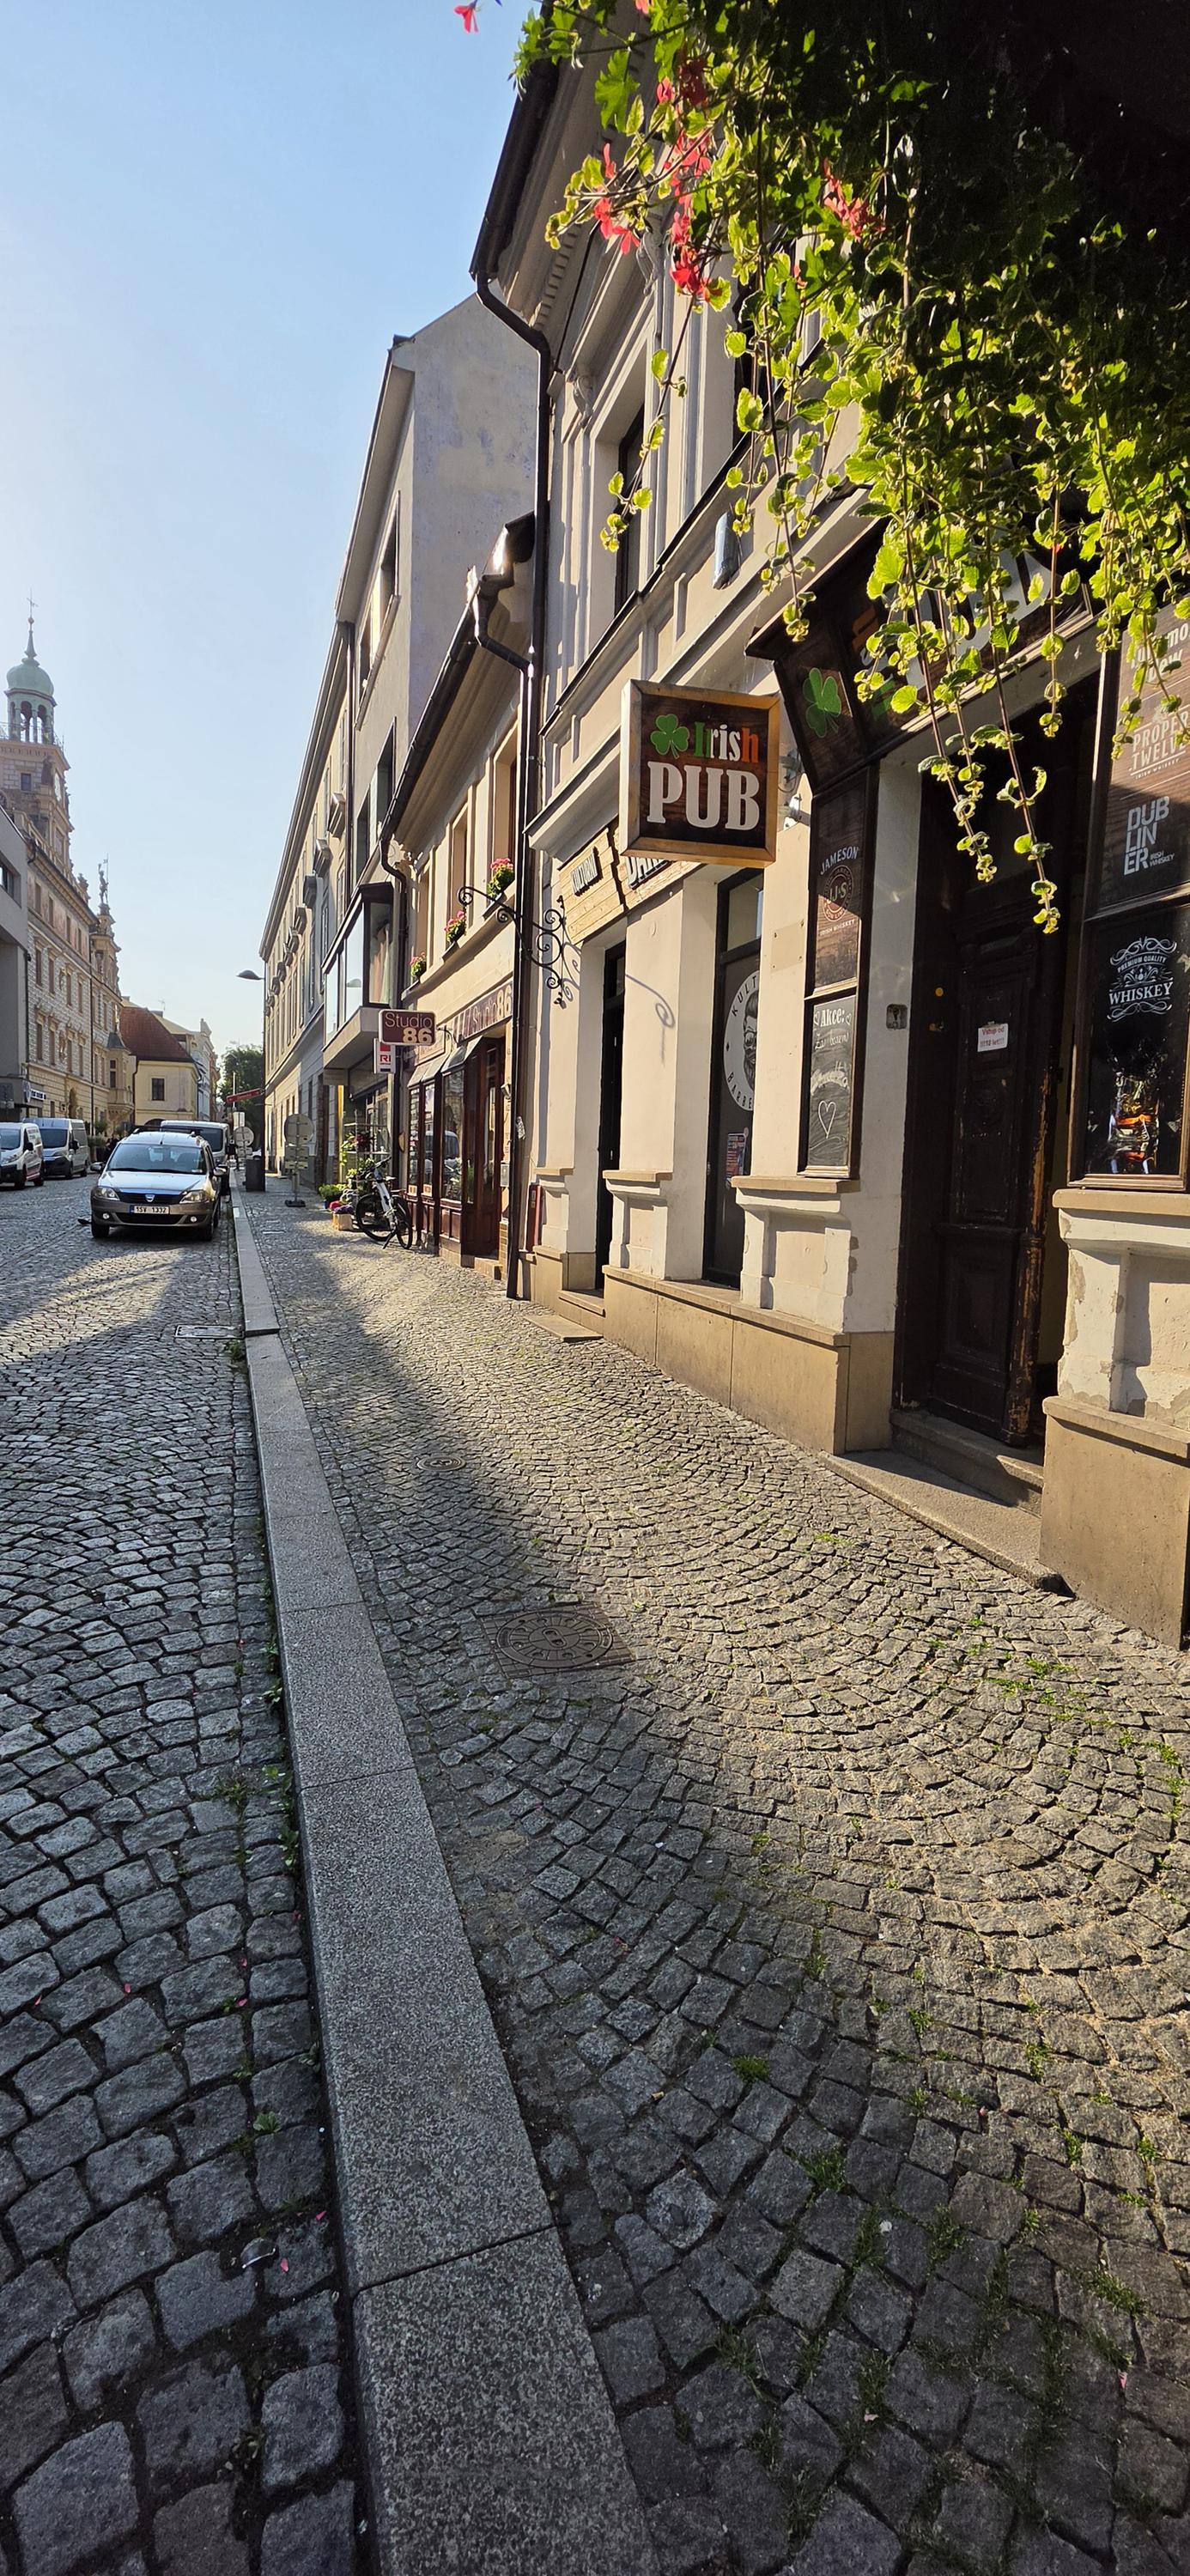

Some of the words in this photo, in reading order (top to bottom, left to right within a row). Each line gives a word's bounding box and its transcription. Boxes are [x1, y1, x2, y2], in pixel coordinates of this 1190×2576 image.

[694, 721, 759, 762] Irish
[647, 761, 760, 830] PUB
[1127, 796, 1169, 831] DUB
[1126, 822, 1157, 853] LIN
[820, 846, 859, 875] JAMESON
[1124, 847, 1149, 876] ER
[1150, 854, 1175, 867] WHISKEY
[1117, 956, 1143, 973] PREMIUM
[1143, 955, 1168, 963] QUALITY
[497, 984, 512, 1021] 86
[1108, 981, 1174, 1005] WHISKEY
[385, 1012, 433, 1029] Studio
[820, 1008, 846, 1028] Akce:
[403, 1027, 433, 1044] 86
